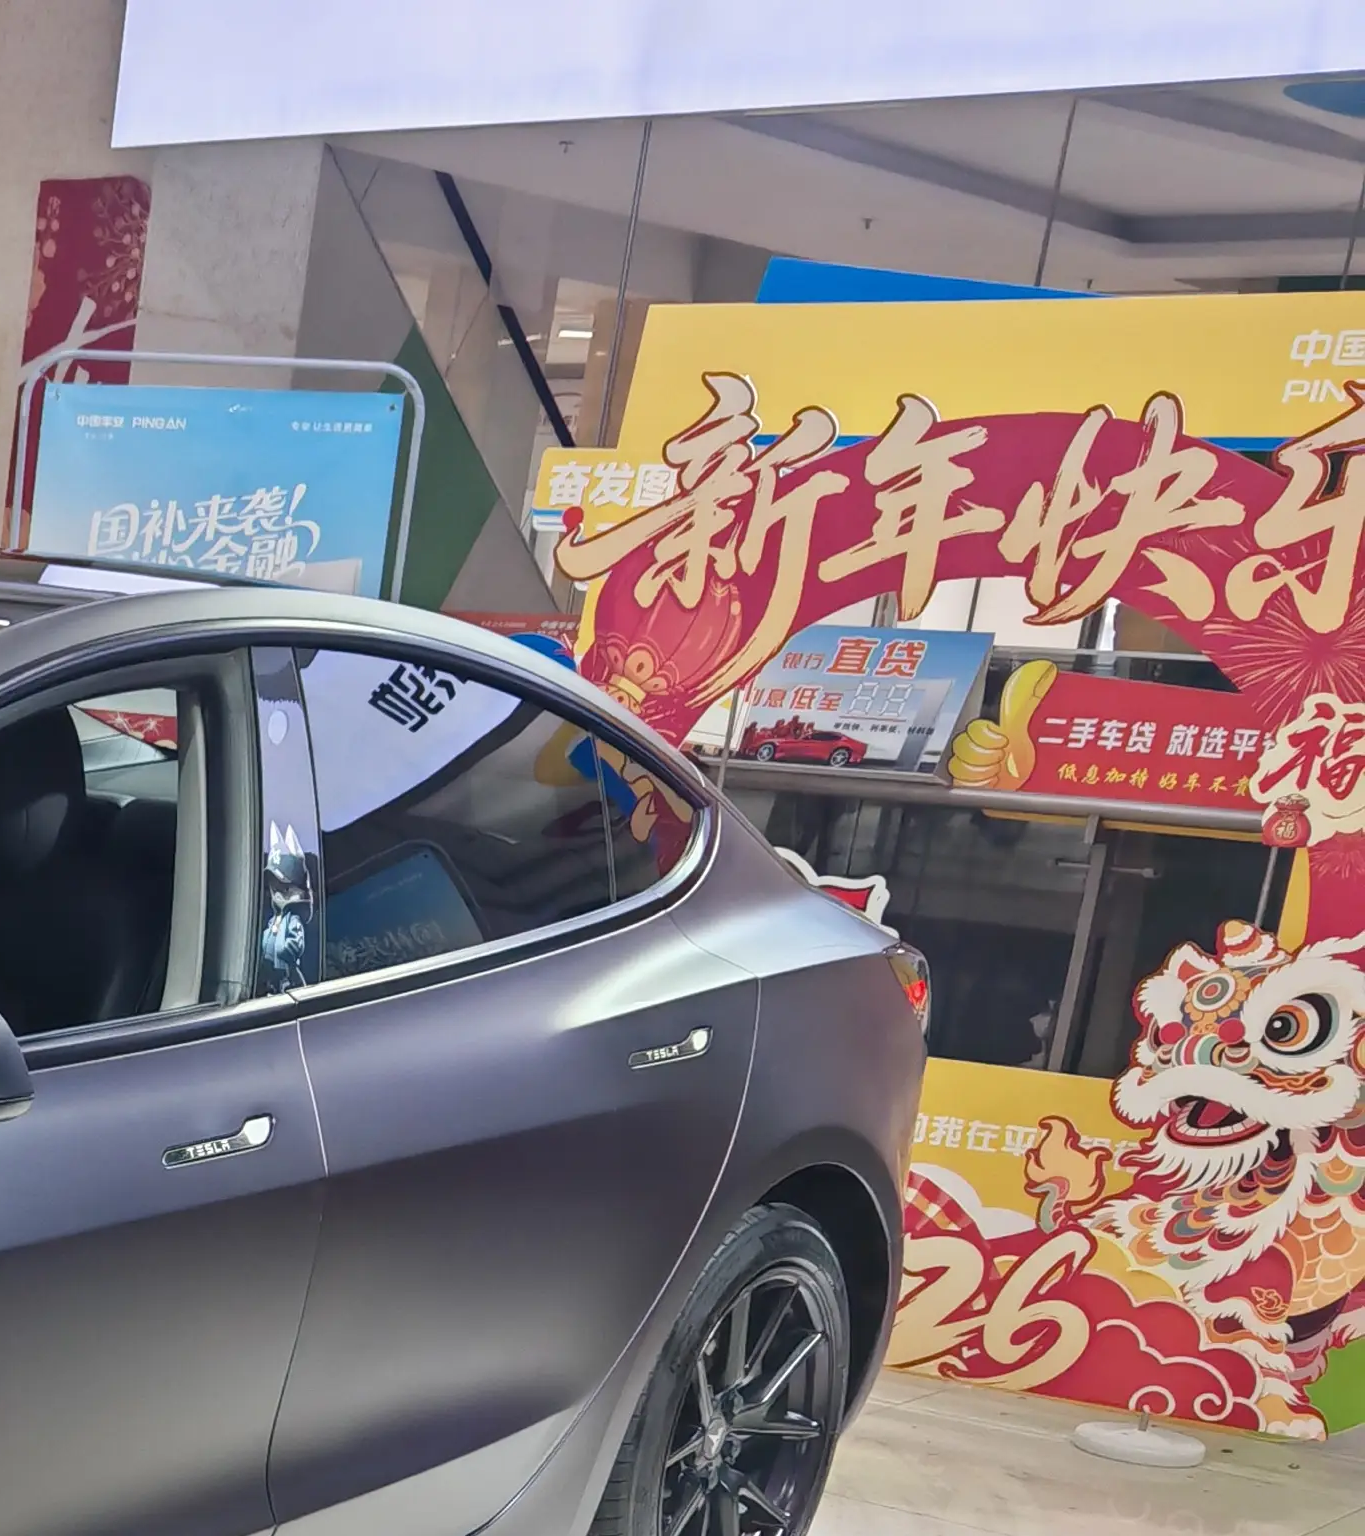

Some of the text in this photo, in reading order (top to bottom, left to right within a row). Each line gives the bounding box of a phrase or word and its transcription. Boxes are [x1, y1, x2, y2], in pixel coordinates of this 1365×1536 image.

[782, 636, 929, 678] 银行 直贷
[1038, 717, 1157, 753] 二手车贷
[1258, 702, 1365, 801] 福
[1057, 762, 1149, 790] 低息加持
[645, 1045, 680, 1061] TESLA
[185, 1138, 231, 1159] TESLA
